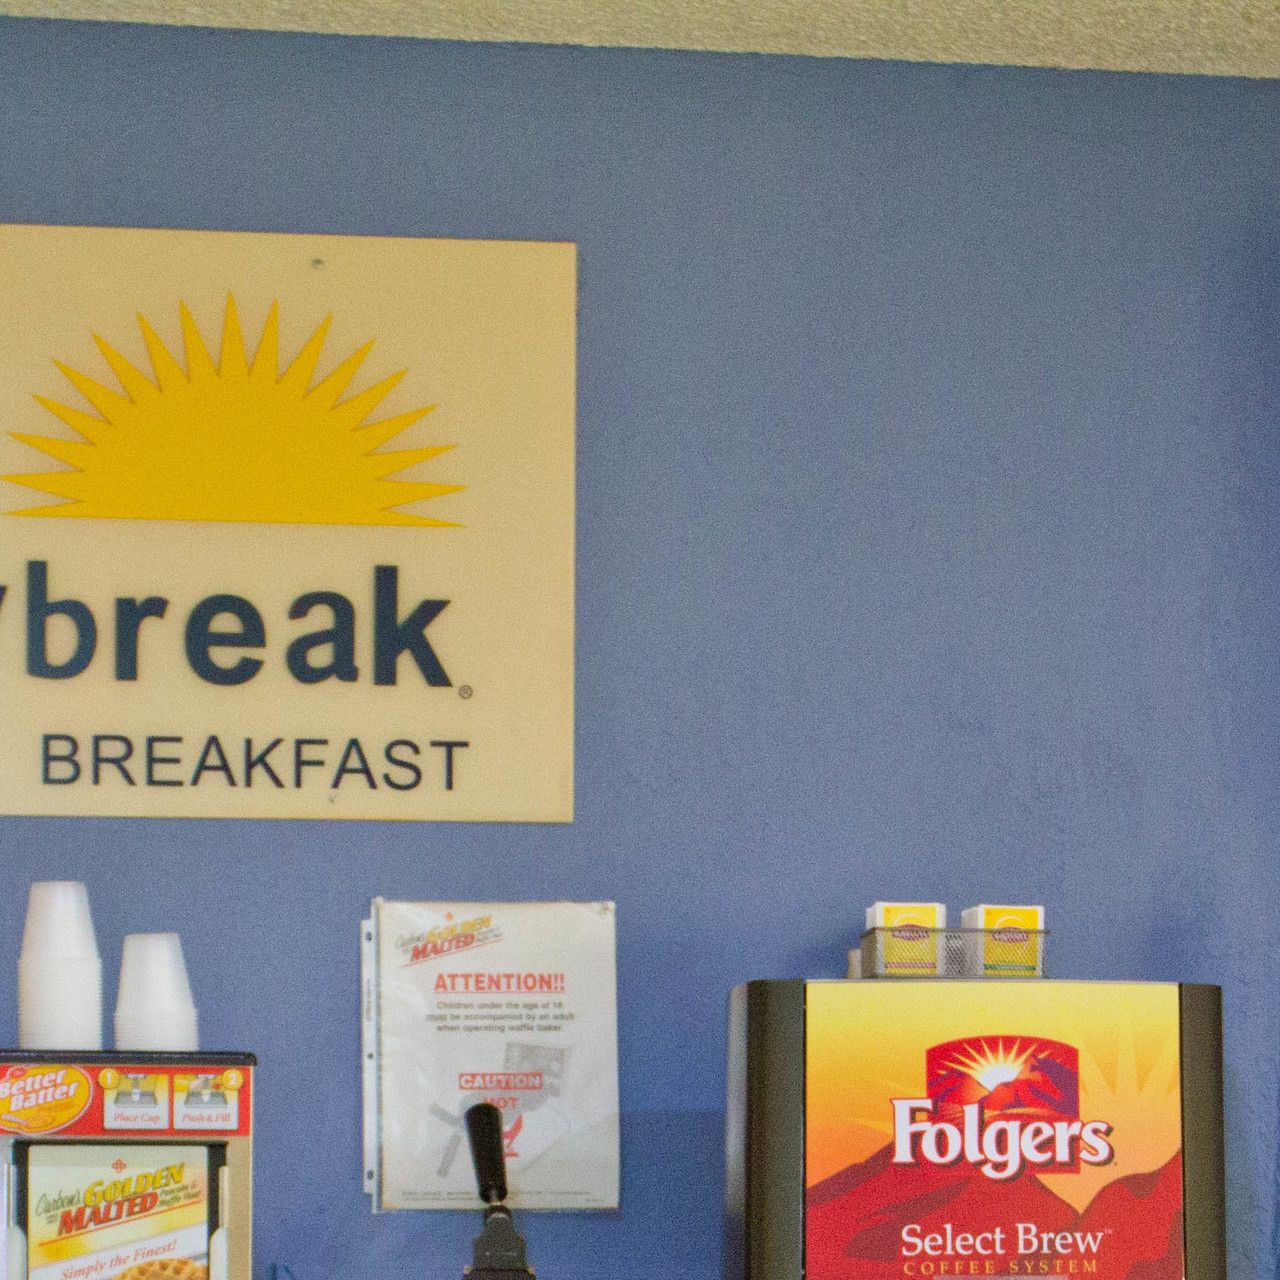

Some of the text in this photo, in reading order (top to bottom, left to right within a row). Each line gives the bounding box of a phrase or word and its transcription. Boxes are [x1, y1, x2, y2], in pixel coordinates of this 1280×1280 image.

[42, 734, 470, 791] BREAKFAST
[434, 972, 565, 992] ATTENTION!!
[9, 1080, 81, 1112] Batter
[460, 1074, 542, 1088] CAUTION
[892, 1098, 1112, 1181] Folgers
[84, 1163, 186, 1207] GOLDEN
[58, 1191, 159, 1235] MALTED
[109, 1252, 129, 1268] the
[133, 1238, 177, 1262] Finest!
[901, 1222, 1104, 1256] Select Brew
[903, 1259, 1098, 1276] COFFEE SYSTEM
